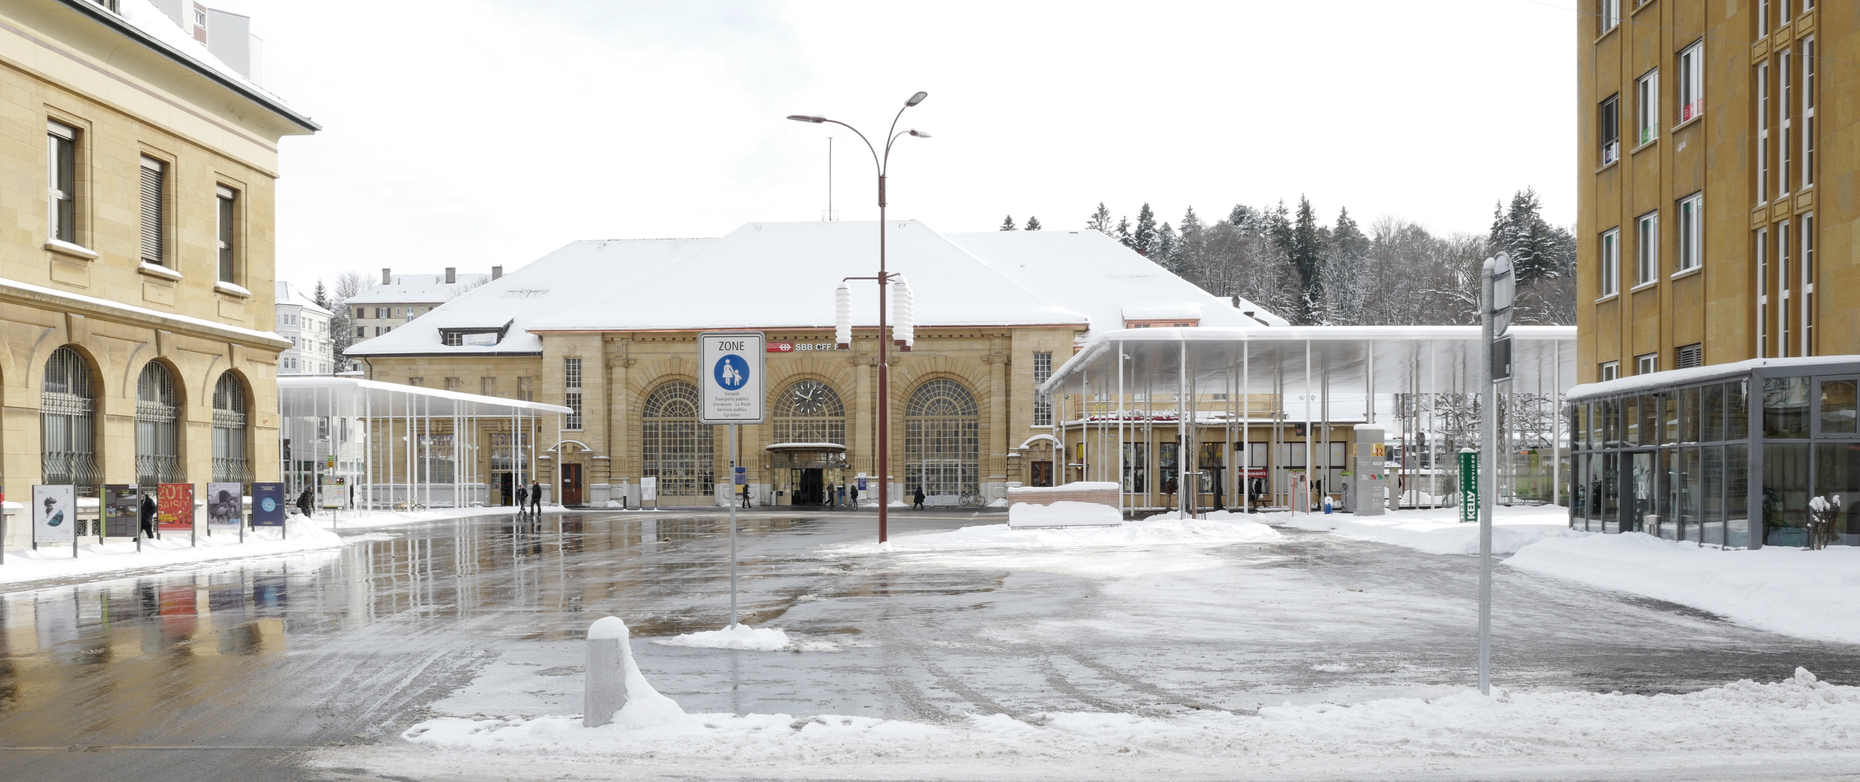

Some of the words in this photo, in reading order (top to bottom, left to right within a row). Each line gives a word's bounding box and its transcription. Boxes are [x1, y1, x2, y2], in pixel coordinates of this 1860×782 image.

[718, 341, 745, 351] ZONE
[795, 343, 813, 351] SBB
[815, 343, 832, 351] CFF
[158, 484, 192, 499] 2015
[1638, 482, 1646, 499] R
[1467, 490, 1476, 519] KELLY
